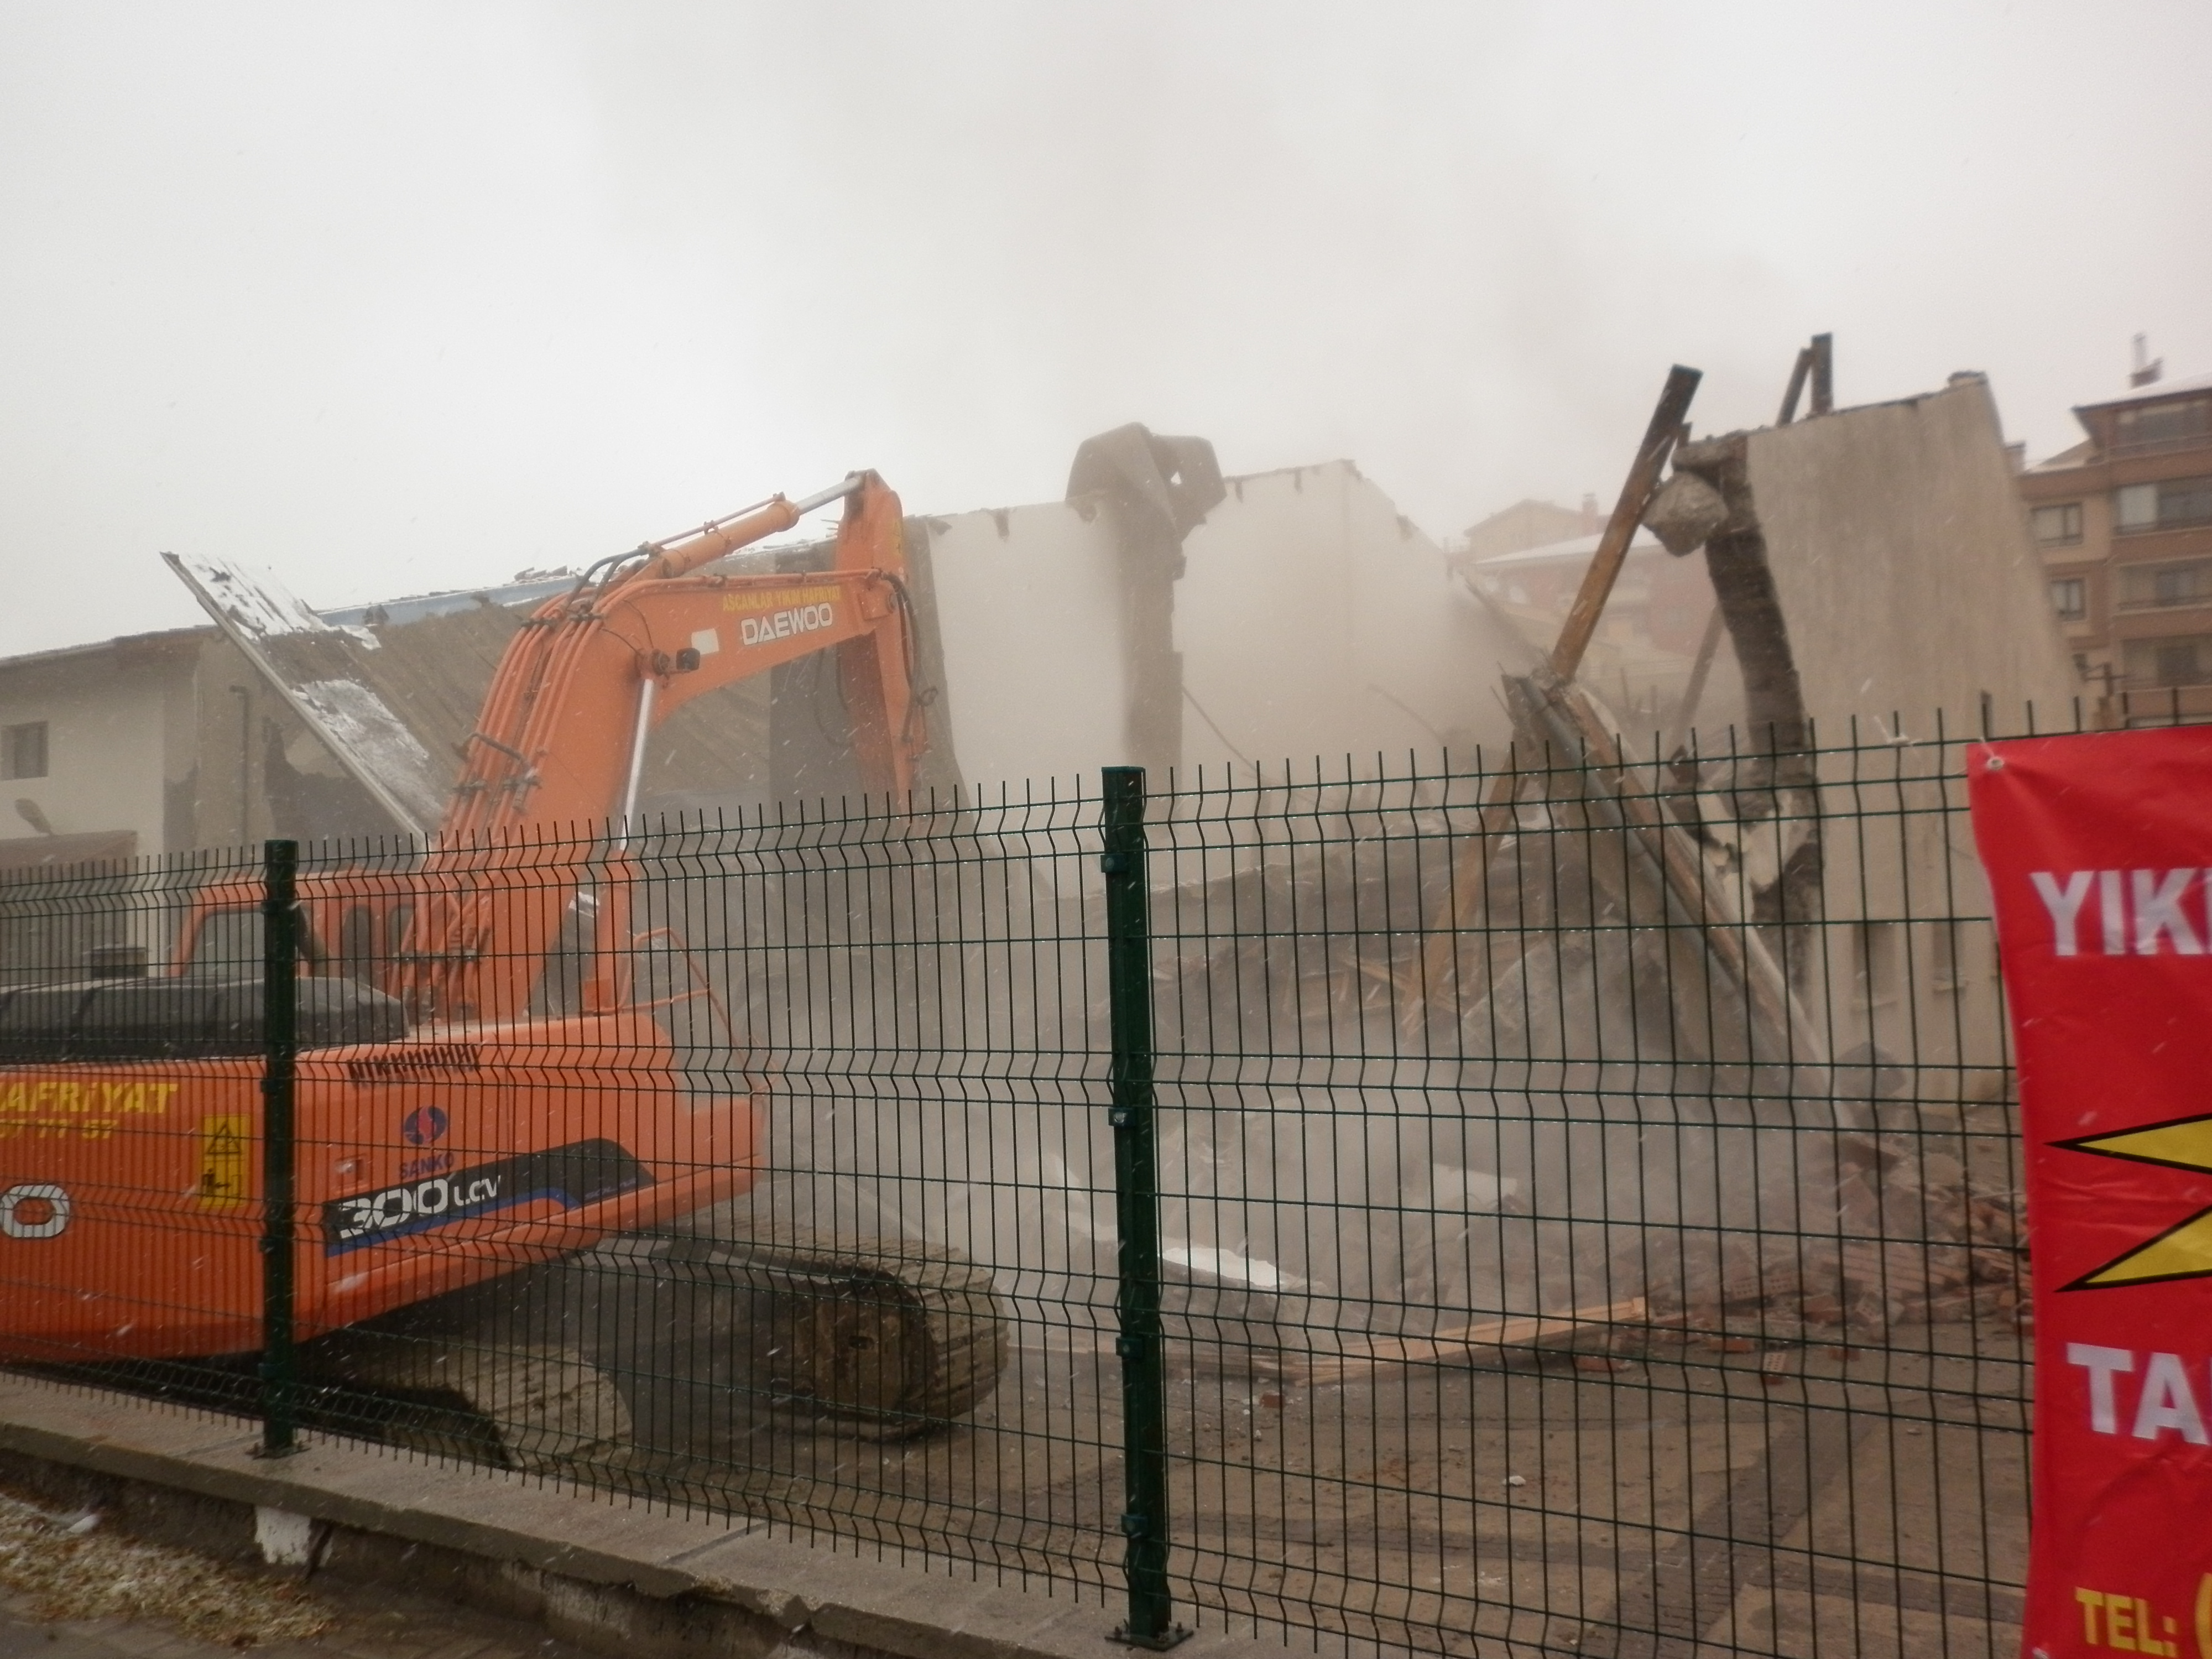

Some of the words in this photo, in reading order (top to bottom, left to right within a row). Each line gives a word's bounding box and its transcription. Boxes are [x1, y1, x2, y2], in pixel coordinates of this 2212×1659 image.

[741, 602, 833, 645] DAEWOO
[2028, 868, 2212, 956] YIK
[400, 1152, 454, 1178] SANKO
[2067, 1342, 2212, 1446] TA
[2075, 1586, 2178, 1657] TEL:
